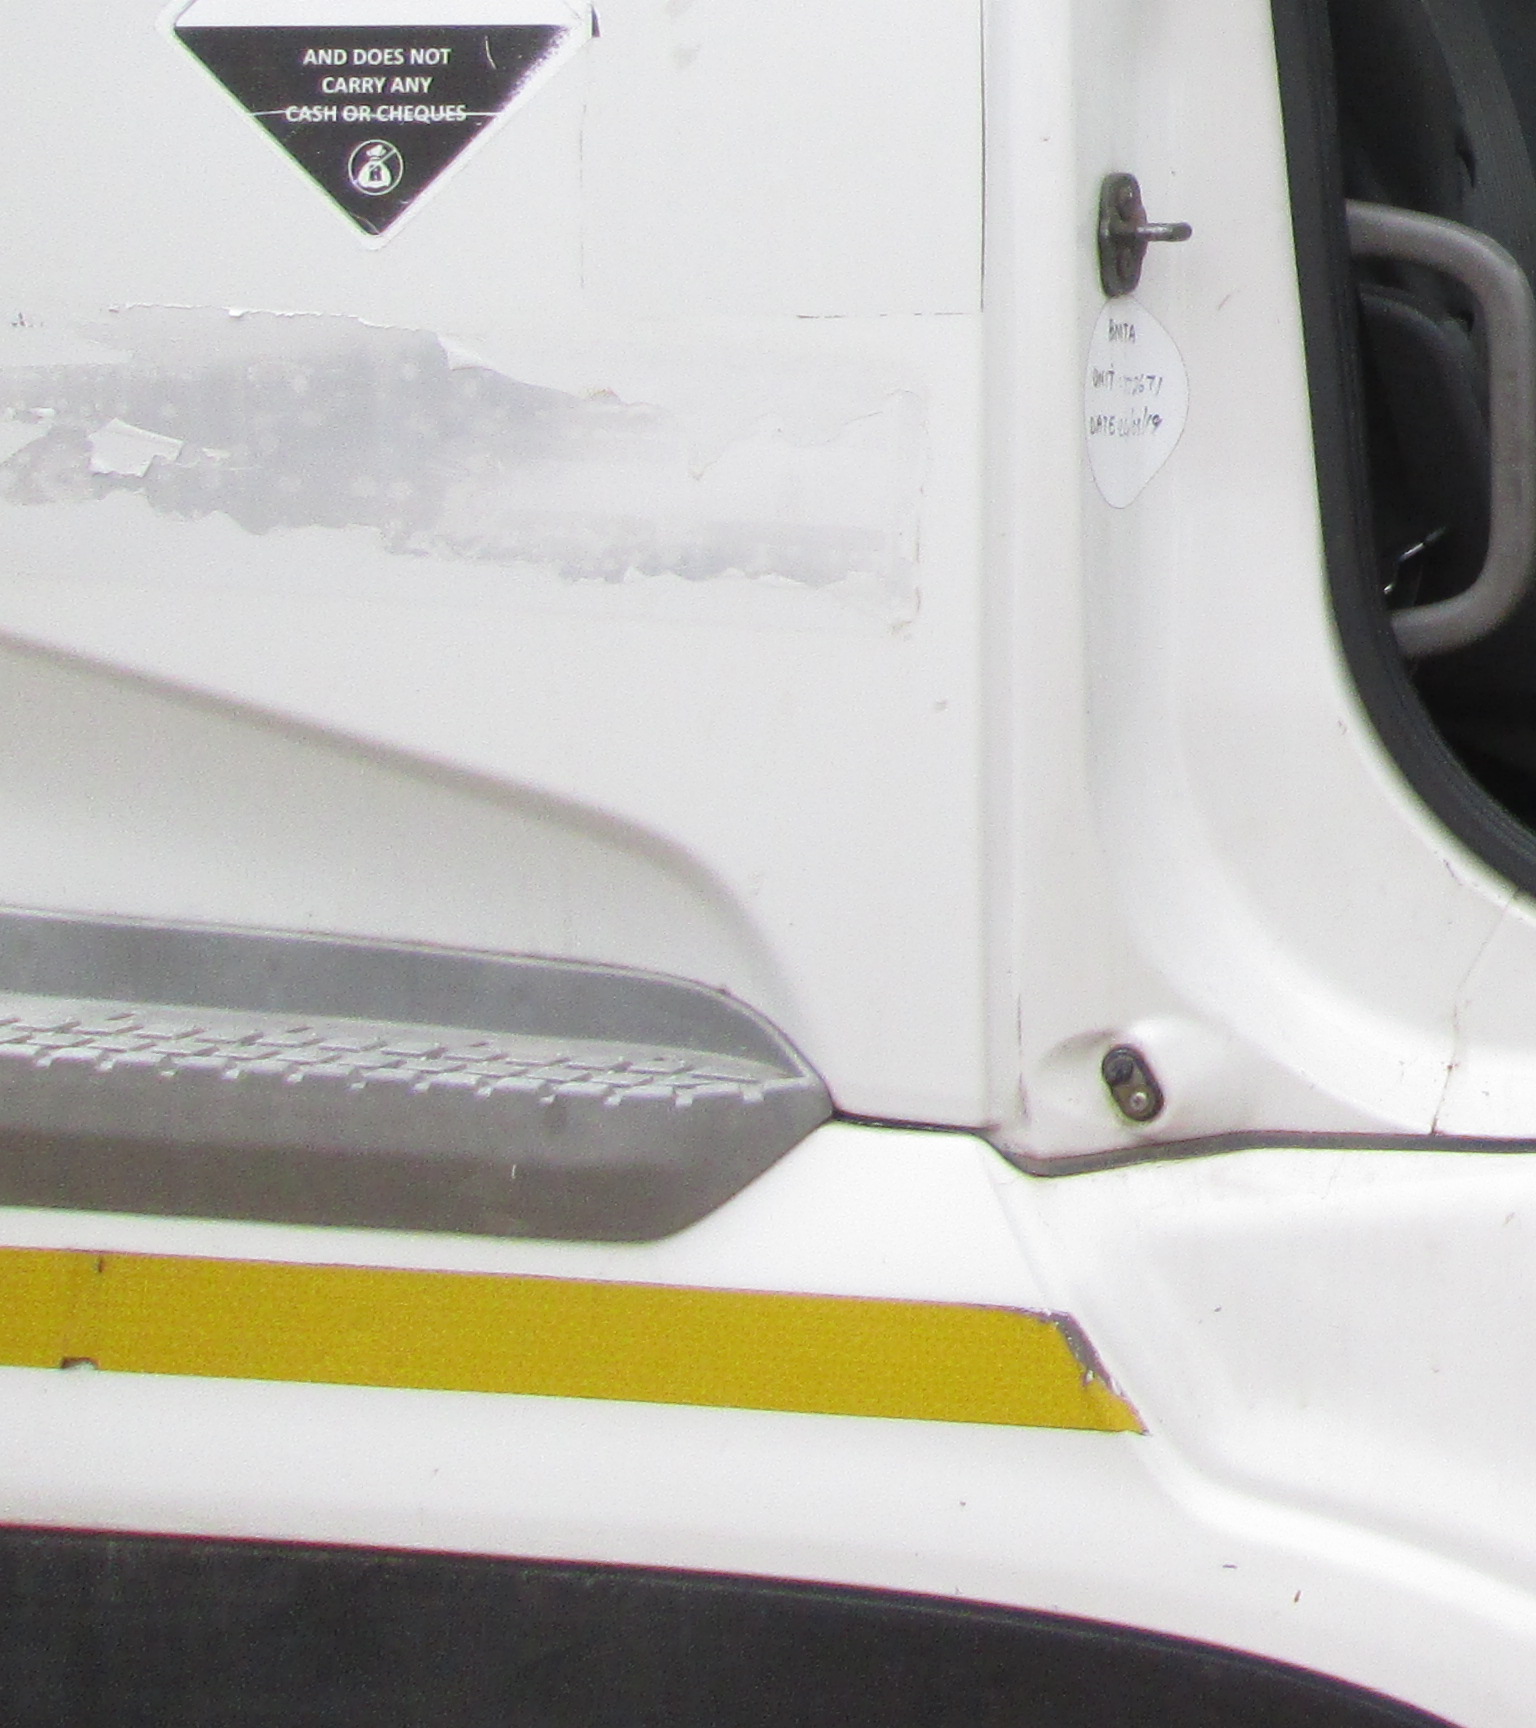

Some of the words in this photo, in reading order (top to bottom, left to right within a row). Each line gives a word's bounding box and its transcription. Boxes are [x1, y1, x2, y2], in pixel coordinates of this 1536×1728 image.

[303, 48, 348, 65] AND
[353, 48, 405, 65] DOES
[410, 48, 452, 65] NOT
[322, 76, 386, 94] CARRY
[390, 76, 433, 93] ANY
[285, 105, 337, 122] CASH
[343, 105, 371, 122] OR
[376, 104, 467, 124] CHEQUES
